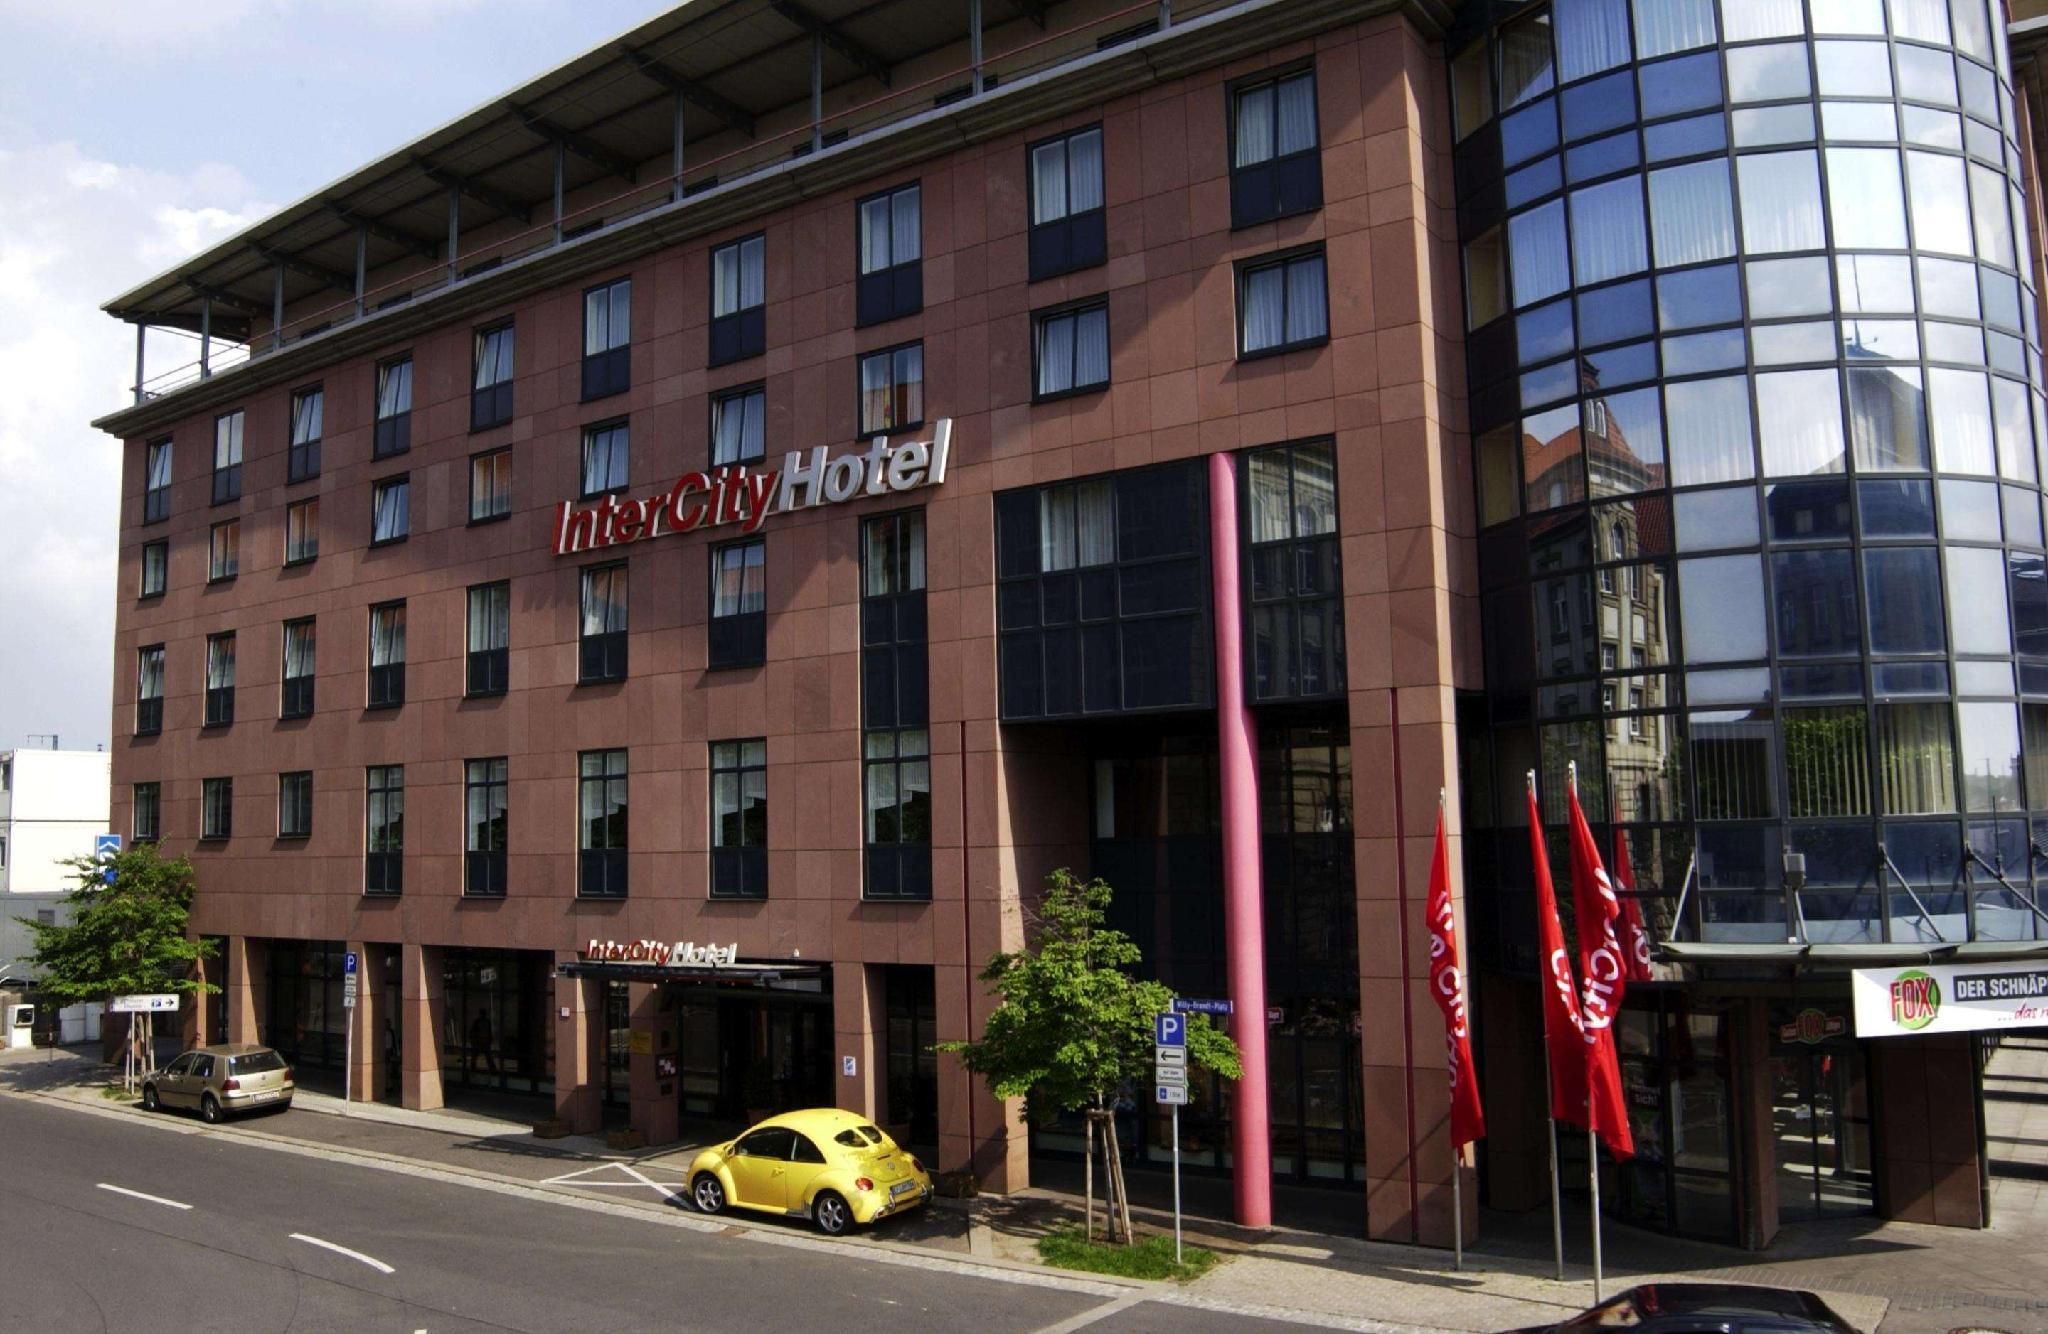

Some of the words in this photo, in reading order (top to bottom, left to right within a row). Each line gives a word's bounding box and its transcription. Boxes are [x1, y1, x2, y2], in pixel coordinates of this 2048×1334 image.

[551, 418, 952, 556] InterCityHotel
[586, 939, 738, 965] InterCityHotel
[1957, 979, 1987, 998] DER
[1990, 973, 2048, 997] SCHNÄP
[1889, 976, 1936, 1023] FOX
[1162, 1017, 1178, 1041] P
